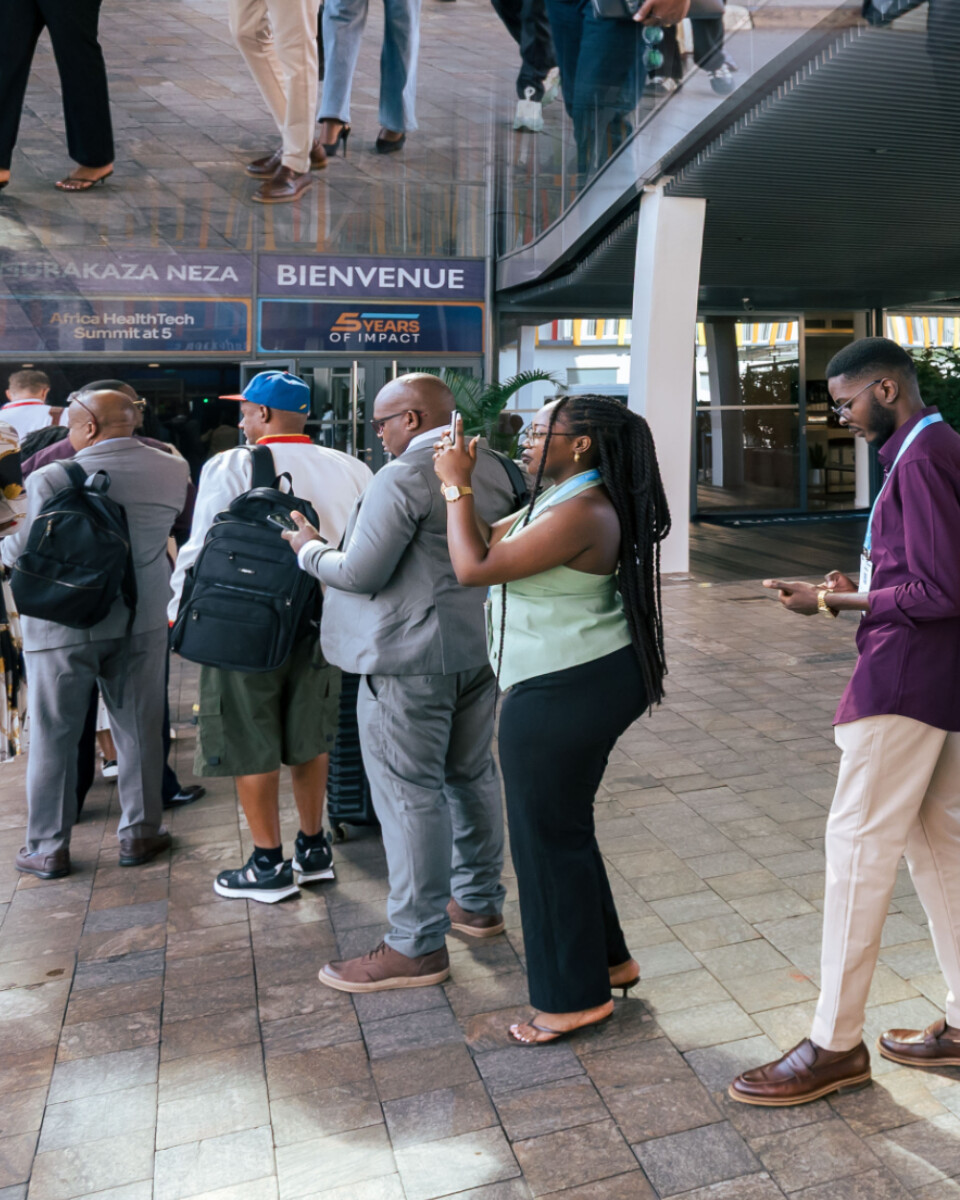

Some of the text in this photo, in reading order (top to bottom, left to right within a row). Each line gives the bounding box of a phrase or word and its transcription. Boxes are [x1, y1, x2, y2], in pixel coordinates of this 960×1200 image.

[167, 265, 239, 282] NEZA
[277, 265, 464, 288] BIENVENUE
[50, 313, 194, 325] Africa HealthTech
[330, 312, 420, 333] 5 YEARS
[74, 328, 172, 339] Summit at 5
[329, 333, 420, 344] OF IMPACT
